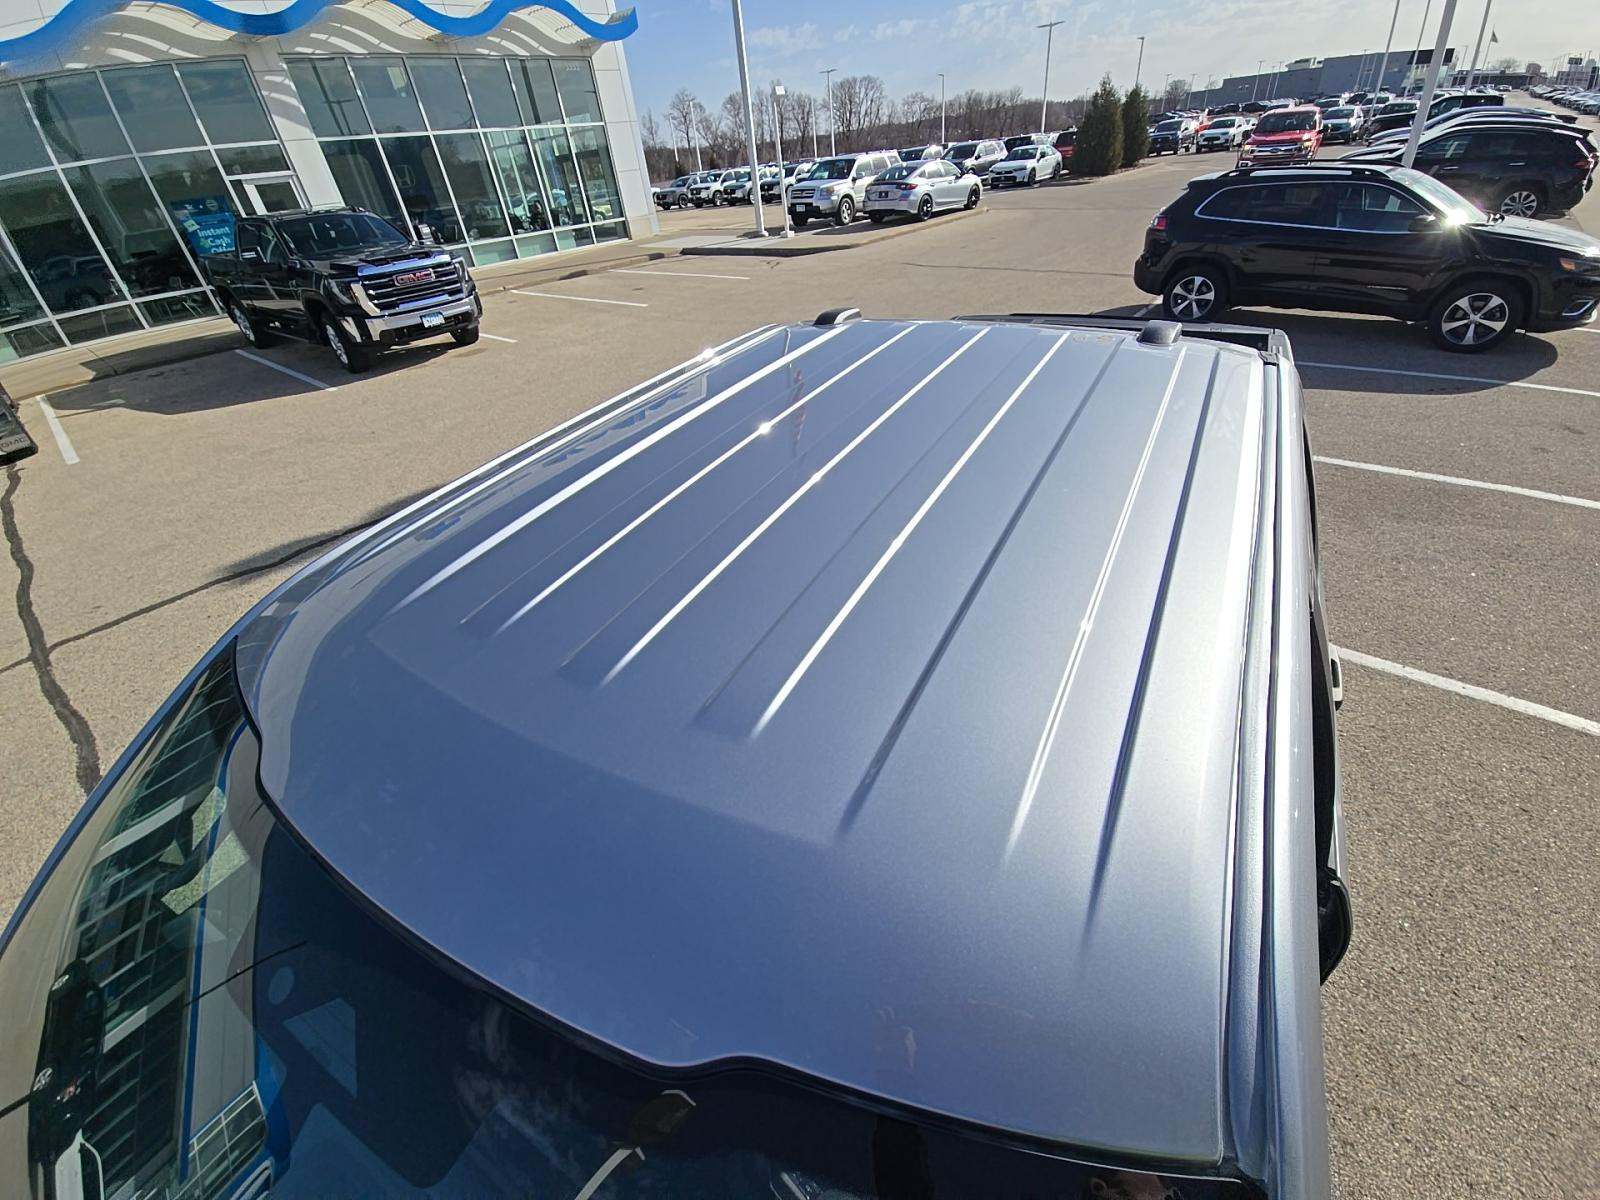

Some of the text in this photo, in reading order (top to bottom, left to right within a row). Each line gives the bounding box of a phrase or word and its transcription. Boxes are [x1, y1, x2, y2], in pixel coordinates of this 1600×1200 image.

[196, 226, 231, 237] Instant
[207, 236, 231, 247] Cash
[396, 270, 432, 284] GMC
